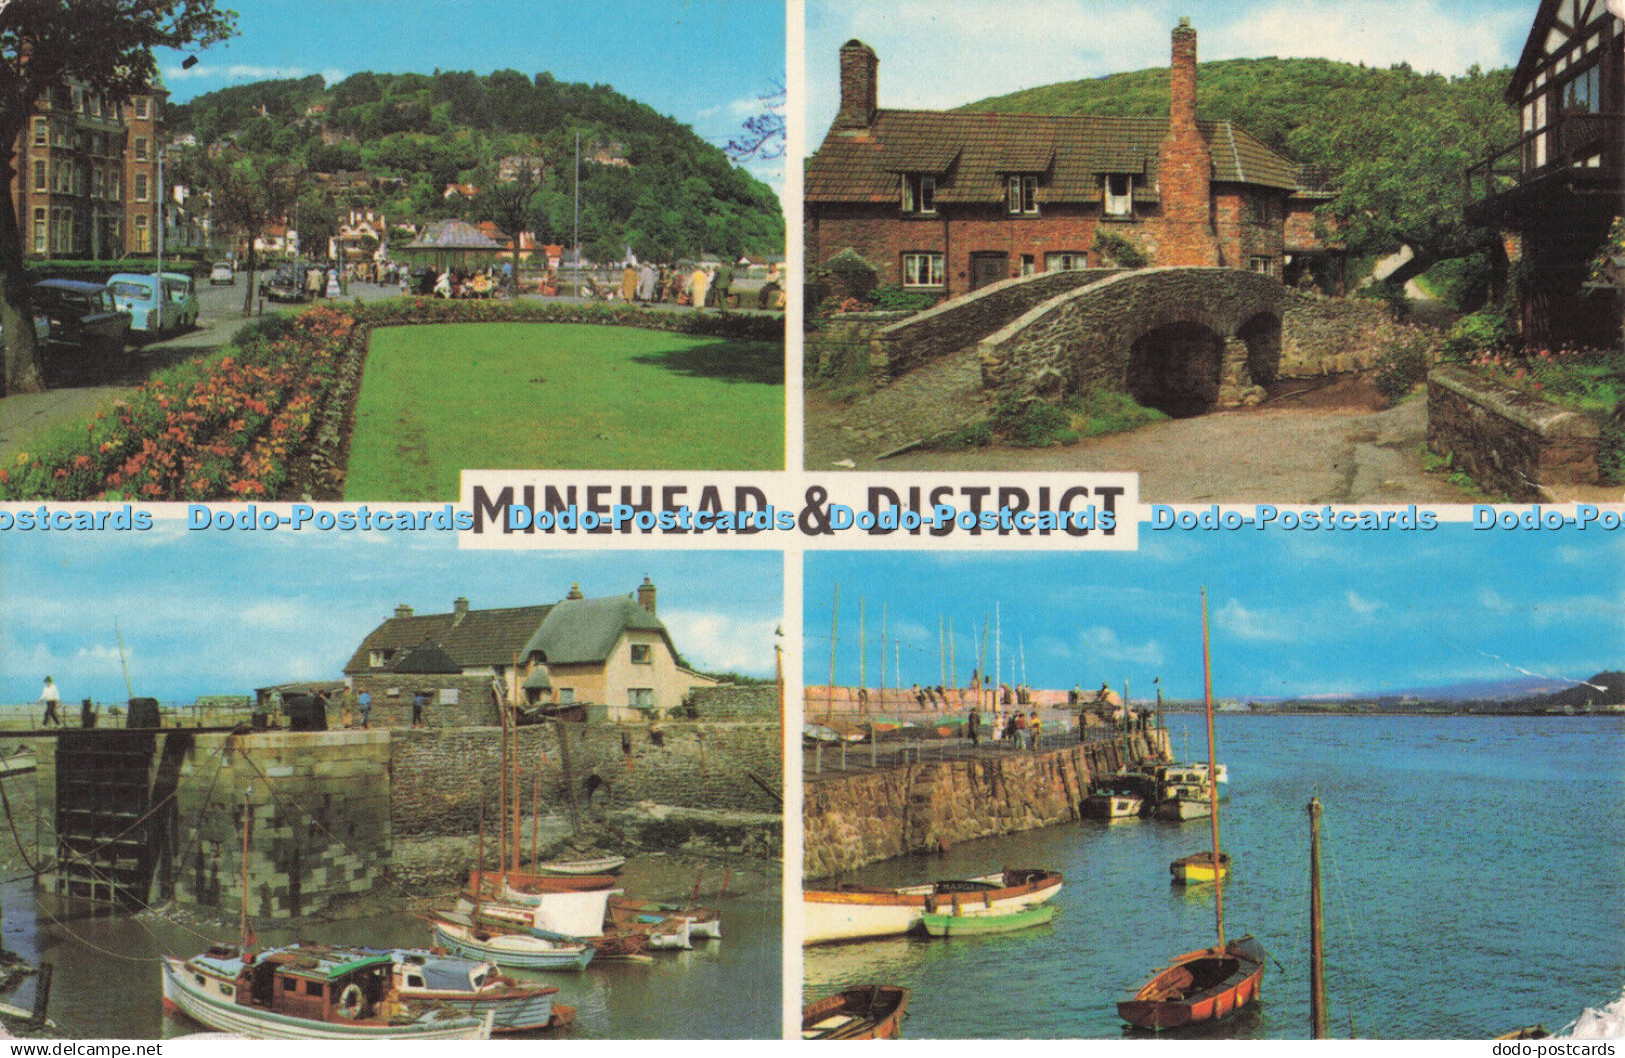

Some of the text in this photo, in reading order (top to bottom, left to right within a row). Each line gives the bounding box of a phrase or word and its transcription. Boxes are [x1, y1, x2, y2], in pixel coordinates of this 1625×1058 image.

[473, 485, 1125, 537] MINEHEAD & DISTRICT
